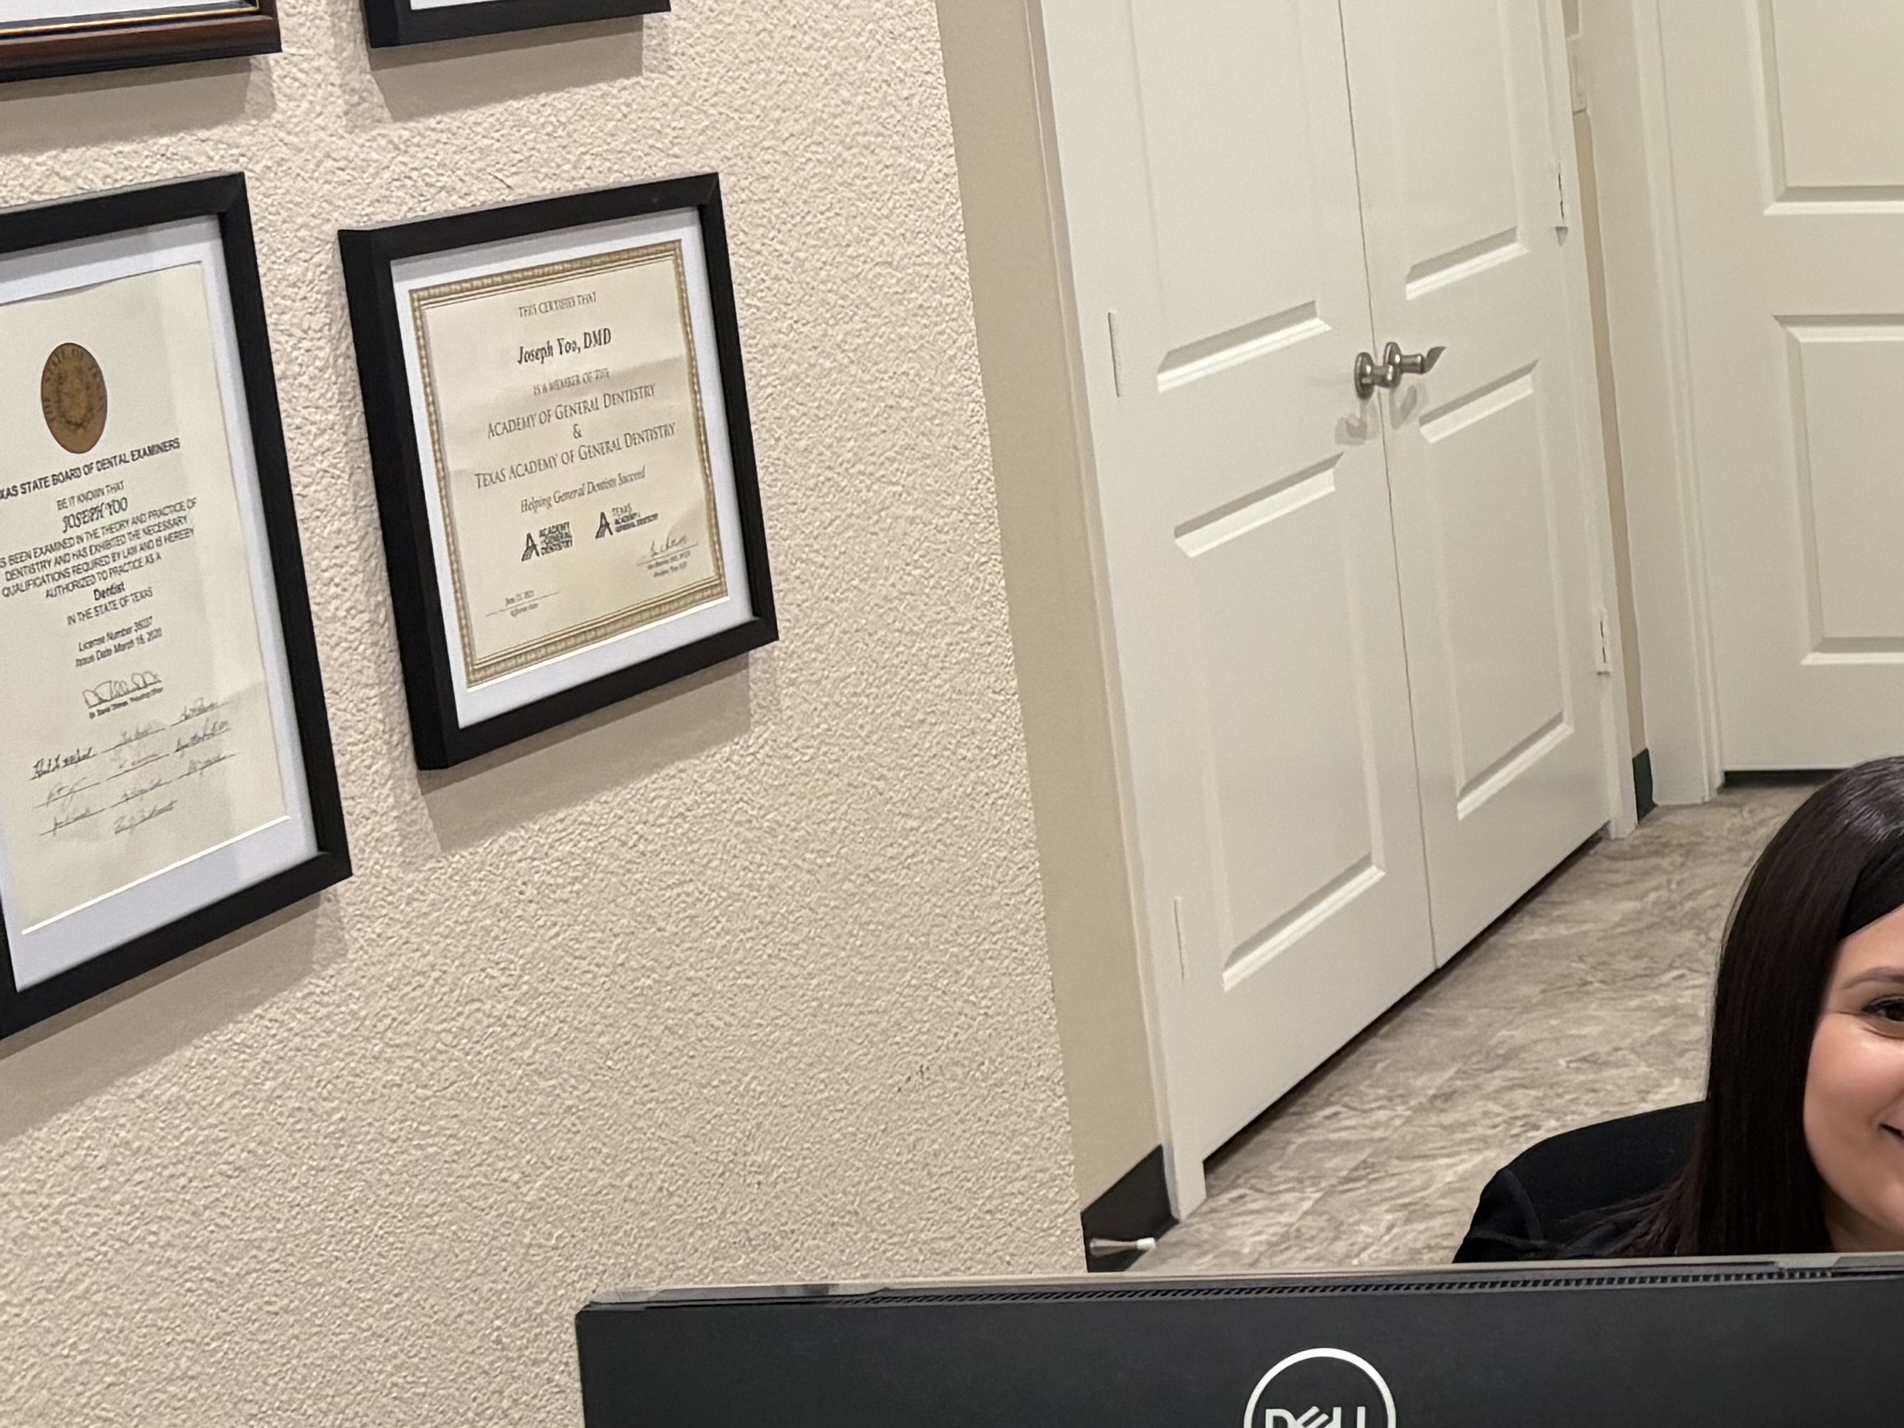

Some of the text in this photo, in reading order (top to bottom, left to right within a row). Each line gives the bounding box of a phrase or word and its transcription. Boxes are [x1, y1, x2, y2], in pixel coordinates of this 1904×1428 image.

[517, 327, 612, 365] Joseph Yoo, DMD
[488, 383, 656, 439] ACADEMY OF GENERAL DENTISTRY
[573, 424, 582, 439] &
[20, 438, 180, 494] STATE BOARD OF DENTAL EXAMINERS
[474, 422, 676, 489] TEXAS ACADEMY OF GENERAL DENTISTRY
[521, 493, 552, 515] Helping
[554, 484, 584, 504] General
[8, 549, 32, 566] BEEN
[33, 536, 76, 559] EXAMINED
[86, 527, 100, 541] THE
[101, 520, 130, 536] THEORY
[131, 513, 147, 526] AND
[148, 501, 186, 519] PRACTICE
[62, 505, 105, 534] JOSEPH
[2, 528, 195, 598] QUALIFICATIONS REQUIRED LAW HEREBY
[5, 559, 53, 582] DENTISTRY
[54, 552, 71, 567] AND
[72, 547, 88, 561] HAS
[143, 516, 188, 538] NECESSARY
[45, 575, 96, 600] AUTHORIZED
[78, 587, 153, 622] THE STATE OF TEXAS
[93, 581, 125, 601] Dentist
